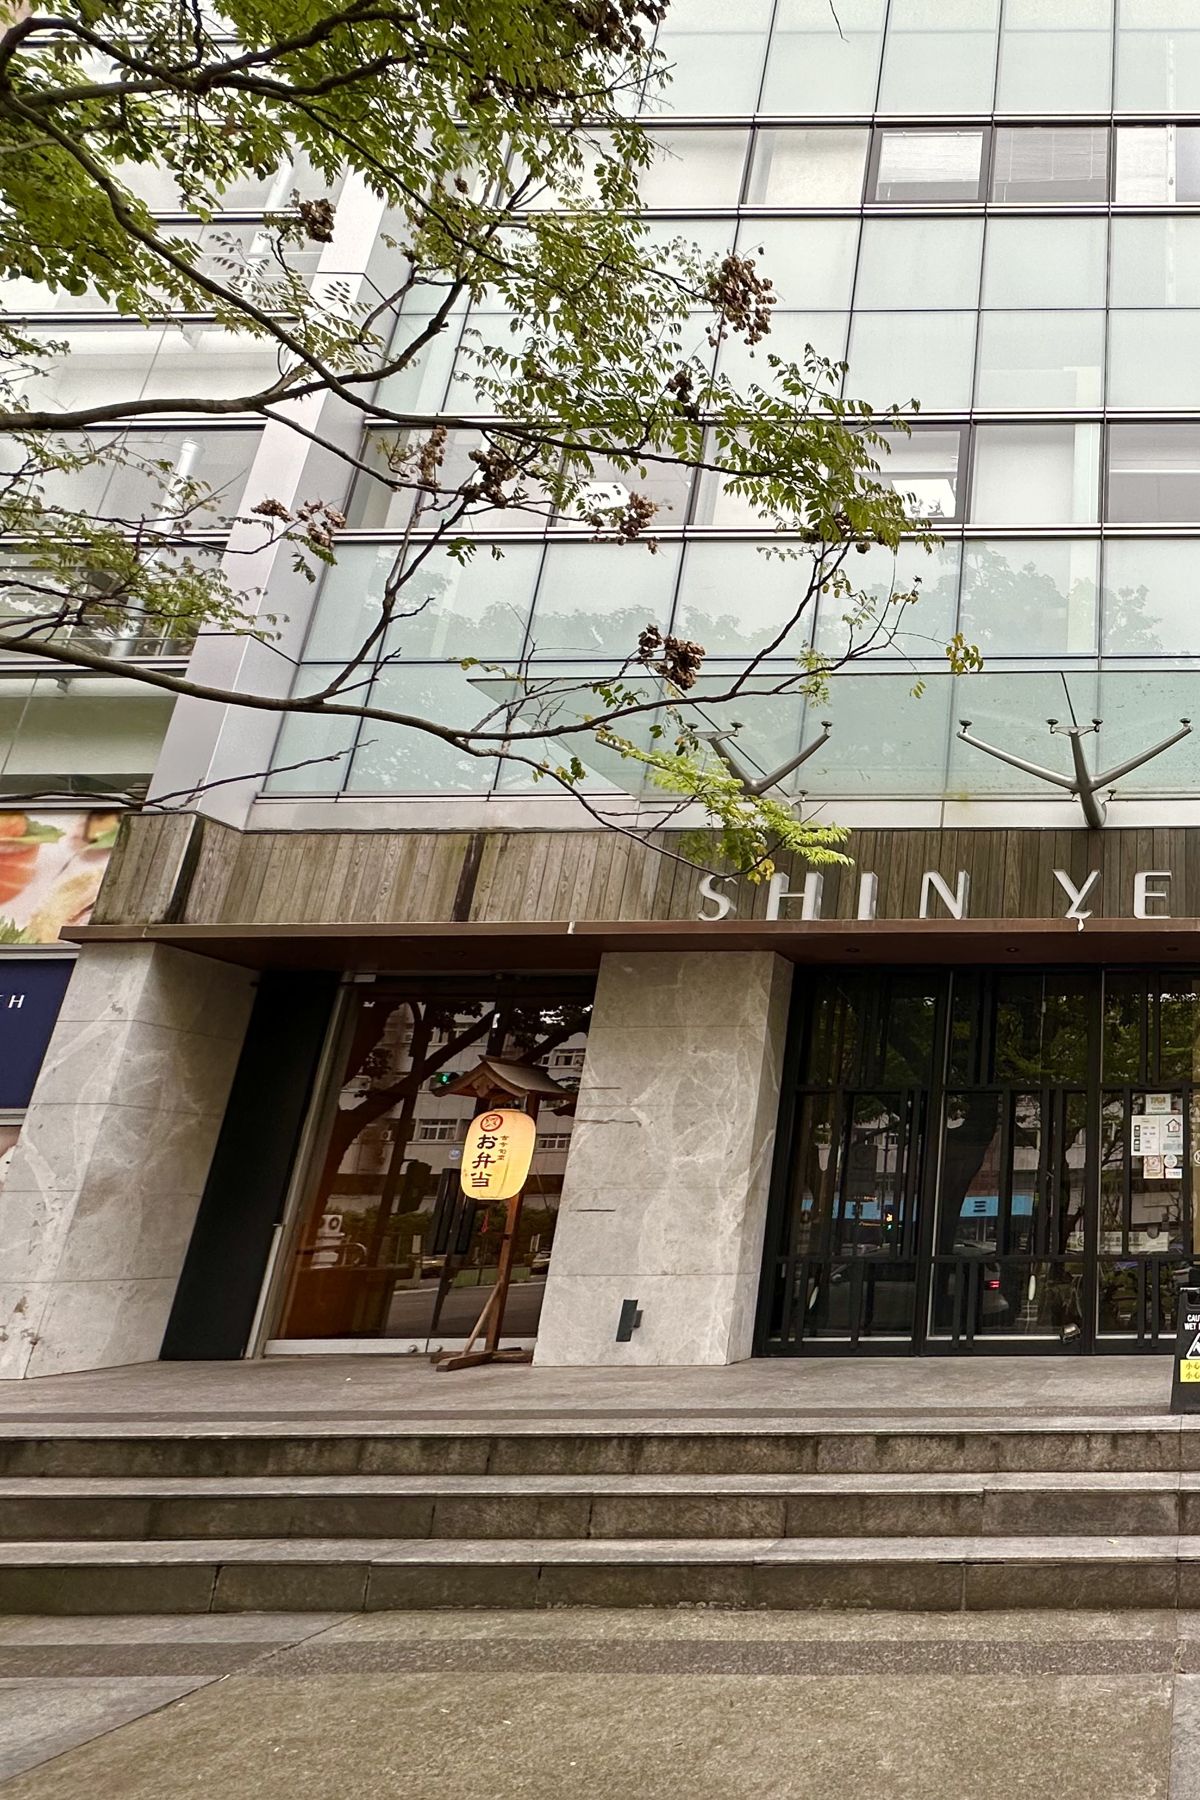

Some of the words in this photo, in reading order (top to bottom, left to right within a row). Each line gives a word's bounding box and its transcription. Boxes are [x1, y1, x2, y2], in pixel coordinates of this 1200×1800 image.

[697, 870, 969, 921] SHIN
[470, 1133, 499, 1188] お弁当
[1184, 1322, 1197, 1330] WET
